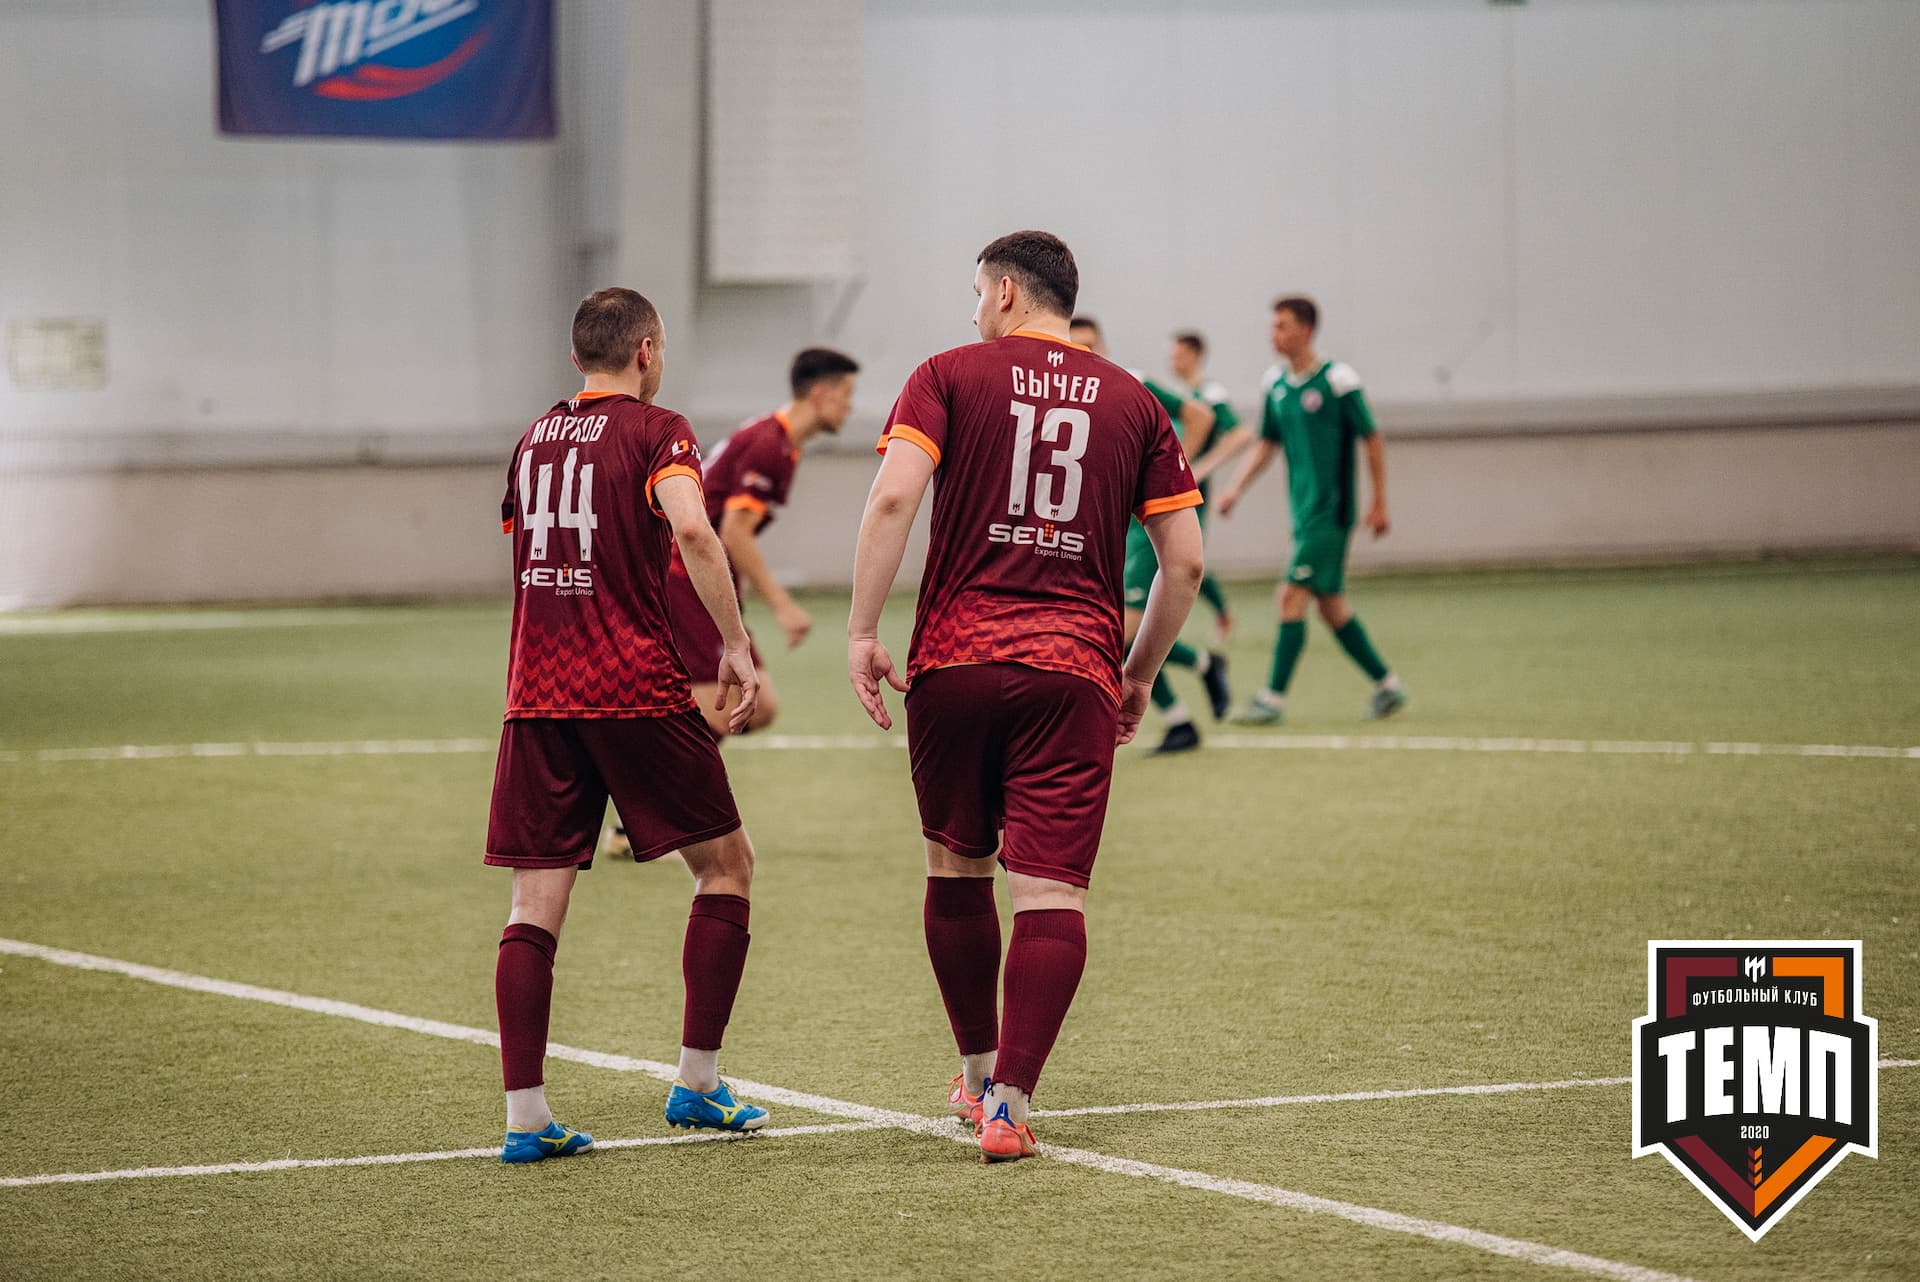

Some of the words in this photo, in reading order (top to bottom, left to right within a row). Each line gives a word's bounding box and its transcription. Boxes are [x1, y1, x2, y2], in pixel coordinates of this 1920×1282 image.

[1011, 365, 1101, 404] СЫЧЕВ
[529, 414, 609, 447] МАРКОВ
[1007, 399, 1091, 522] 13
[518, 447, 598, 562] 44
[1034, 546, 1060, 558] Export
[1060, 551, 1083, 562] Union
